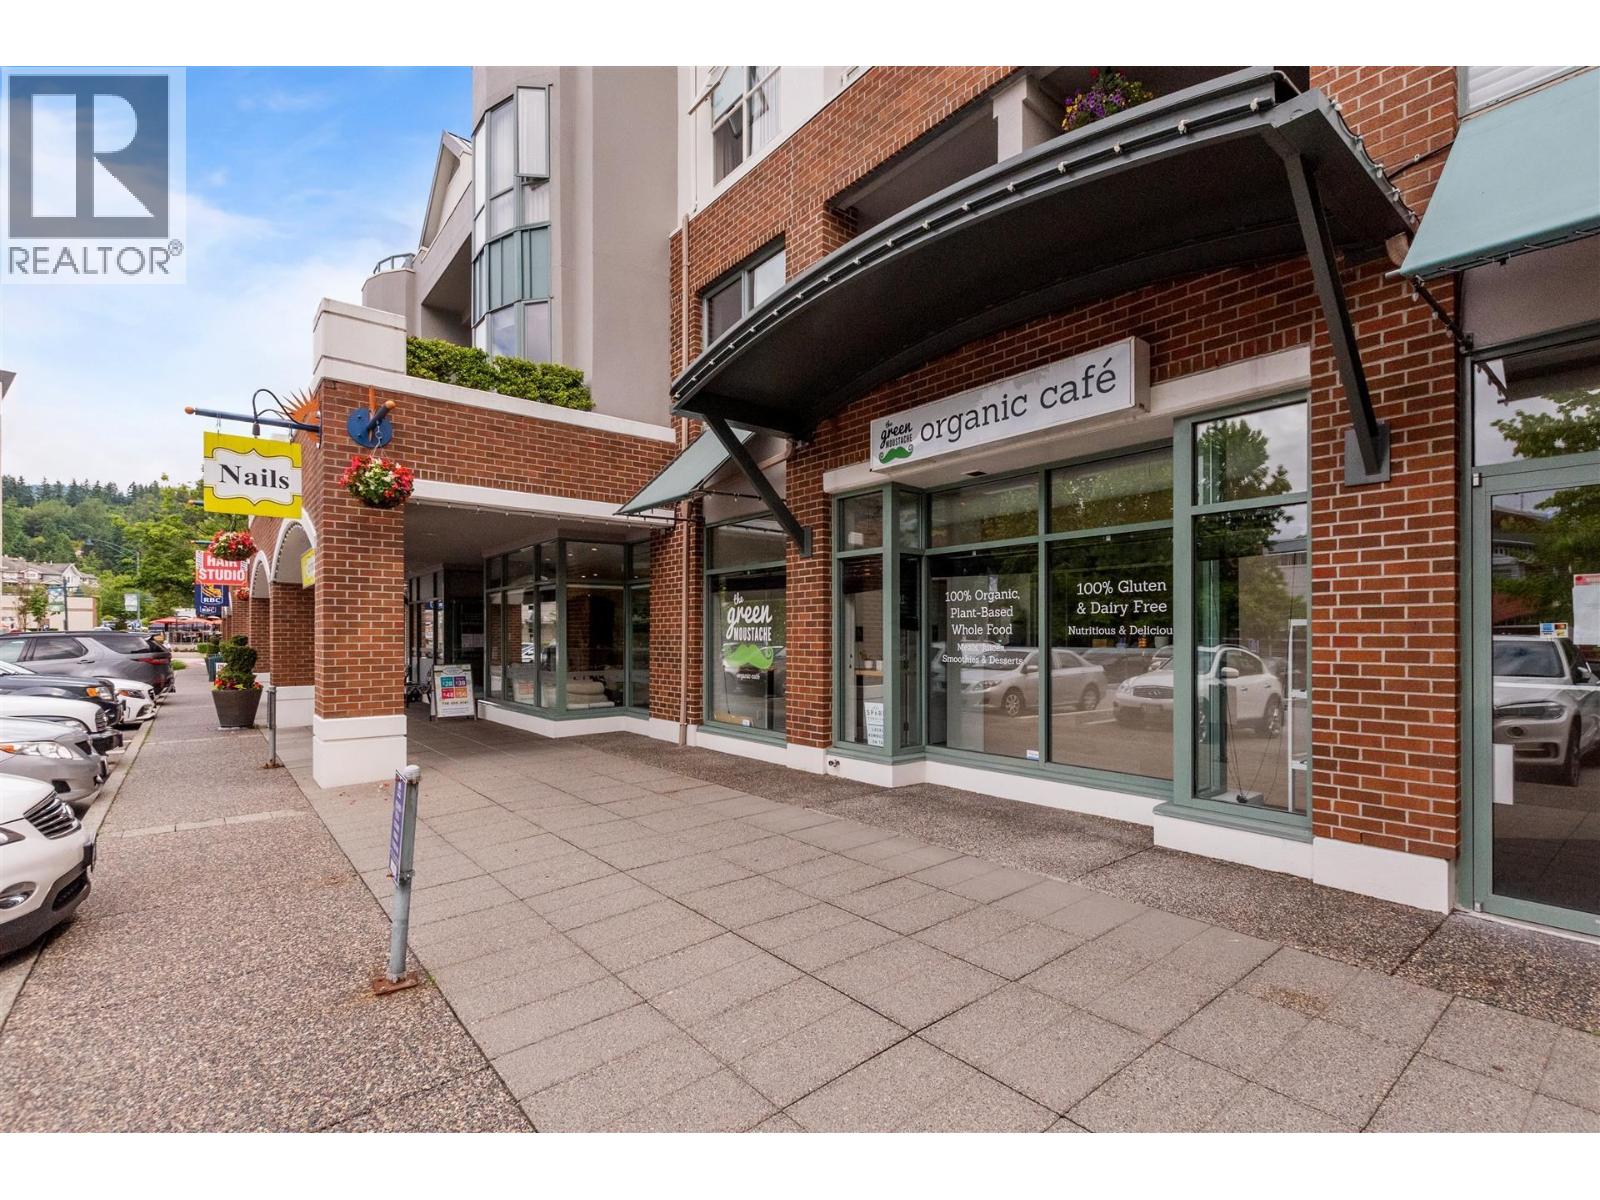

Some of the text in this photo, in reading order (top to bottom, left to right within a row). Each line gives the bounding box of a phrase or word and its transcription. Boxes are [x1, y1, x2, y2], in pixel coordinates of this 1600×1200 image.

[920, 357, 1117, 443] organic café
[880, 421, 913, 449] green
[885, 433, 913, 448] MOUSTACHE
[219, 463, 290, 490] Nails
[198, 568, 246, 581] STUDIO
[1076, 579, 1167, 596] 100% Gluten
[733, 592, 744, 605] the
[945, 589, 1021, 603] 100% Organic,
[950, 605, 1014, 619] Plant-Based
[1076, 599, 1168, 617] & Dairy Free
[725, 605, 773, 640] green
[951, 623, 1014, 635] Whole Food
[733, 626, 772, 642] MOUSTACHE
[1067, 625, 1173, 636] Nutritious & Deliciou
[942, 654, 979, 664] Smoothies
